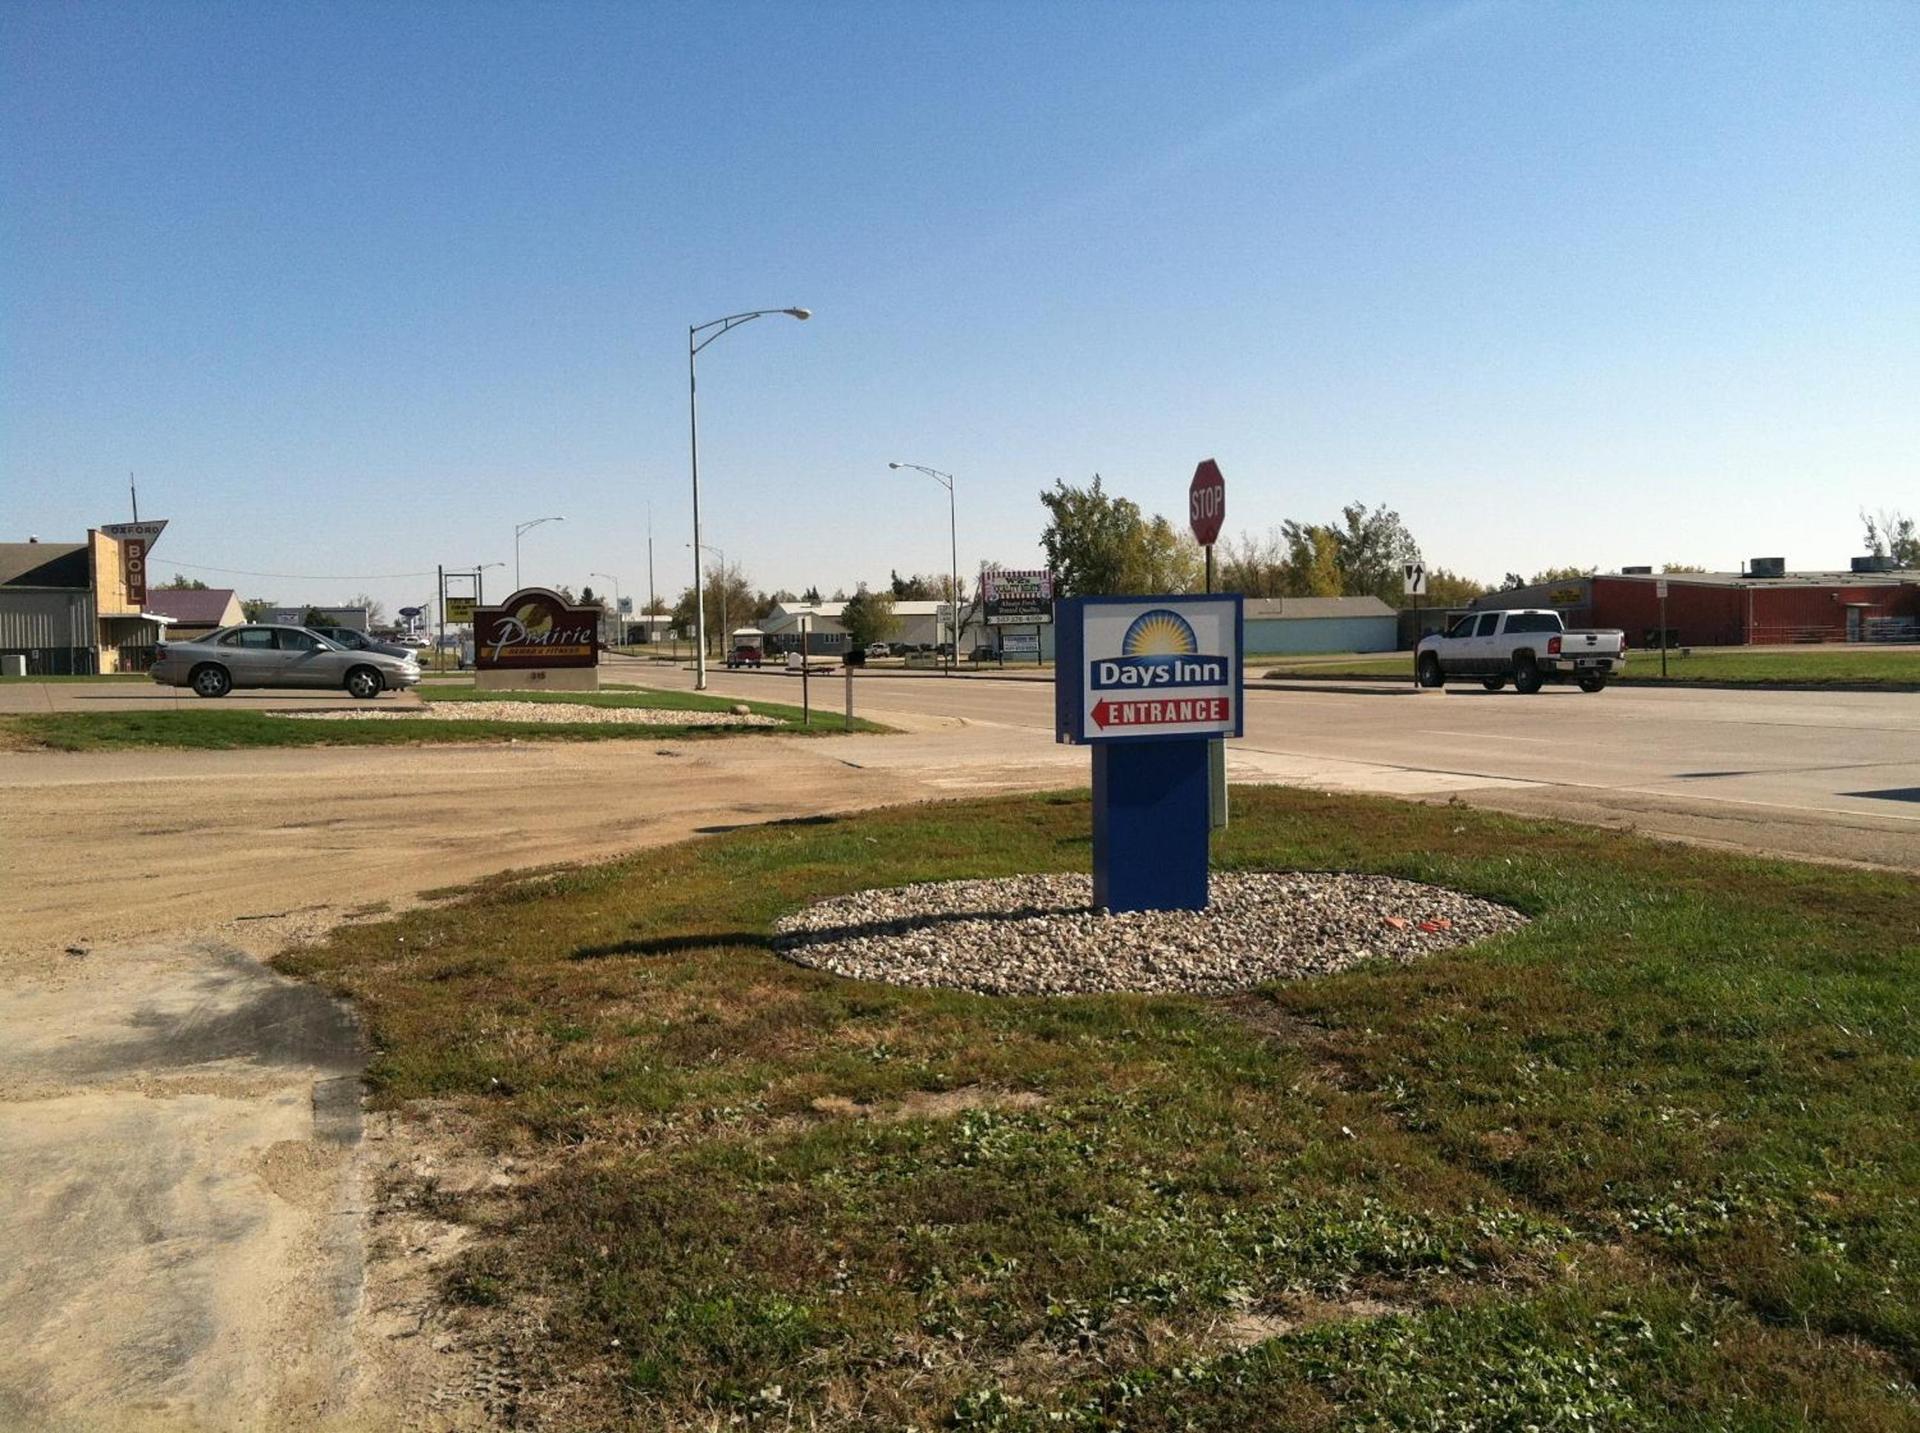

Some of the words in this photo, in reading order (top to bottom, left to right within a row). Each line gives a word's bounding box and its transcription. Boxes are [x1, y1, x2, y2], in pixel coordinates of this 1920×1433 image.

[1192, 485, 1222, 520] STOP
[111, 526, 159, 534] OXFORD
[128, 545, 142, 600] BOWL
[487, 617, 592, 662] Prairie
[1100, 662, 1169, 686] Days
[1175, 661, 1220, 682] Inn
[1109, 700, 1220, 724] ENTRANCE
